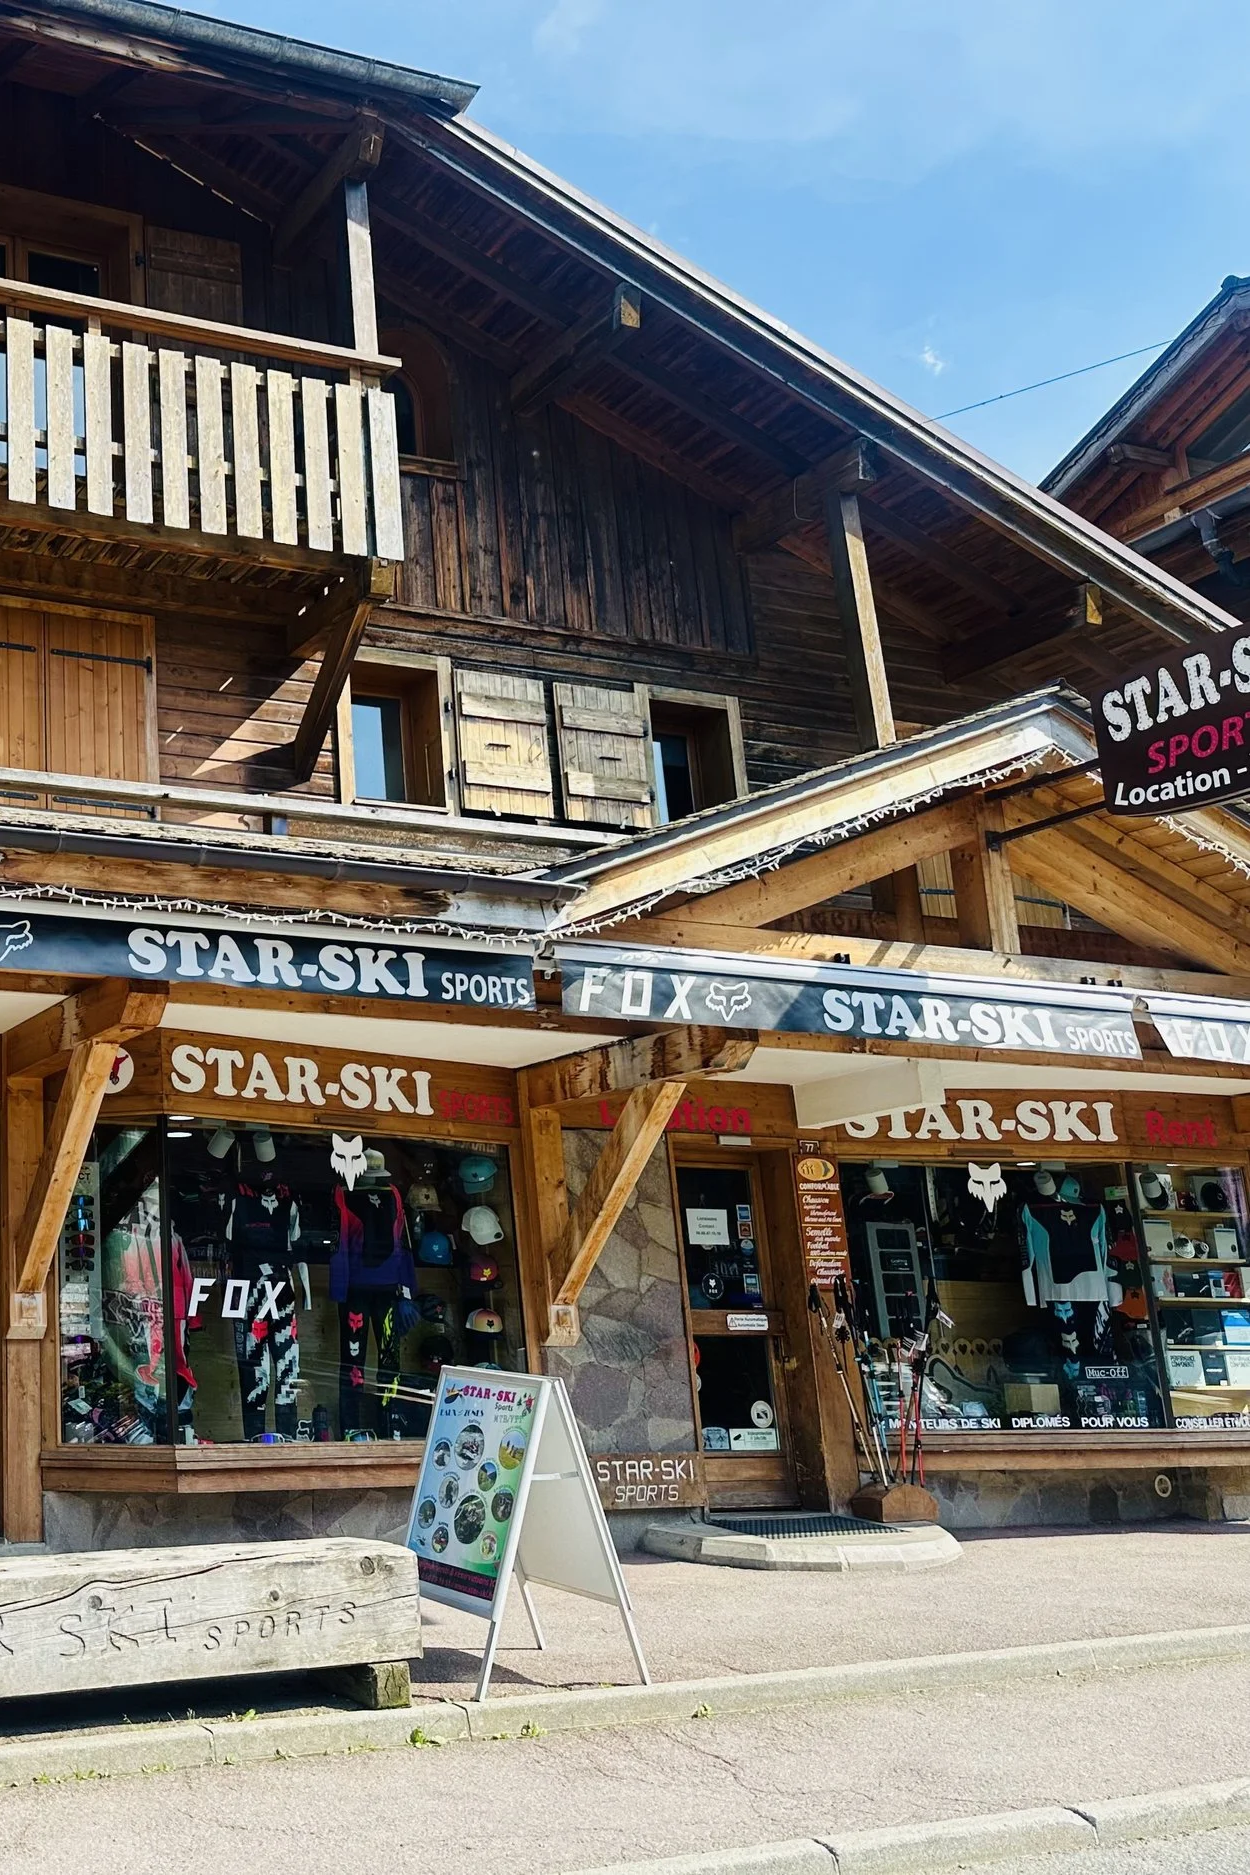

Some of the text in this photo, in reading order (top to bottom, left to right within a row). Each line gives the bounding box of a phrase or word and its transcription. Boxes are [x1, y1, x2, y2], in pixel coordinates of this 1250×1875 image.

[1147, 711, 1250, 774] SPOR
[1114, 767, 1231, 807] Location
[127, 927, 531, 1006] STAR-SKI SPORTS
[578, 967, 697, 1020] FOX
[822, 988, 1138, 1056] STAR-SKI SPORTS
[170, 1043, 515, 1125] STAR-SKI SPORTS
[600, 1097, 752, 1133] Lation
[1144, 1109, 1219, 1147] Rent
[187, 1277, 287, 1321] FOX
[1087, 1367, 1127, 1378] Muc-Off
[961, 1418, 978, 1429] DE
[981, 1417, 1001, 1429] SKI
[1081, 1417, 1114, 1428] POUR
[1116, 1417, 1149, 1428] VOUS
[614, 1484, 680, 1503] SPORTS
[57, 1597, 181, 1659] SKI
[202, 1599, 358, 1652] SPORTS
